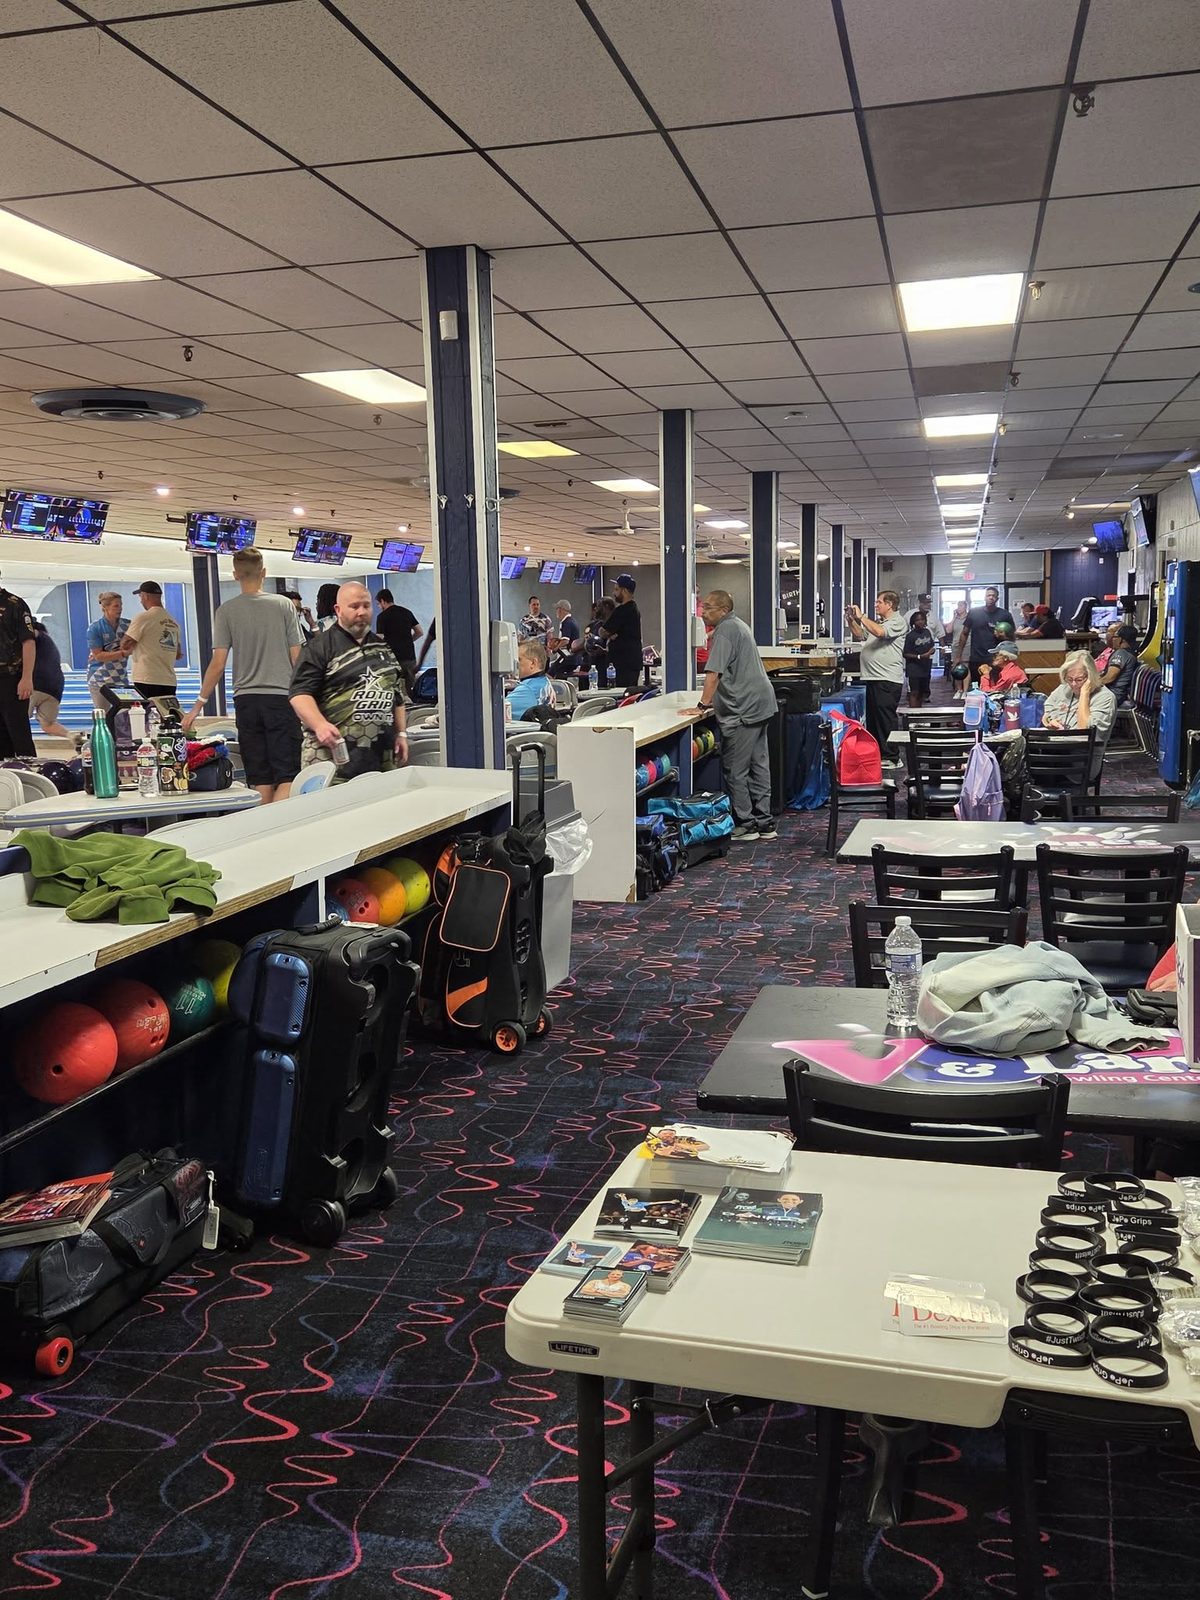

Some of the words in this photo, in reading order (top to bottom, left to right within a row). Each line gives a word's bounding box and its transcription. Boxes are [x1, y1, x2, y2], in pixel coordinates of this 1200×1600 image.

[352, 690, 394, 701] ROTO
[355, 700, 393, 710] GRIP
[353, 712, 383, 721] OWN
[1022, 1052, 1200, 1075] Lan
[937, 1061, 997, 1077] &
[1070, 1074, 1138, 1084] wling
[1065, 1203, 1087, 1213] Grips
[1130, 1216, 1153, 1226] Grips
[555, 1343, 593, 1355] LIFETIME
[1011, 1342, 1030, 1359] Grips
